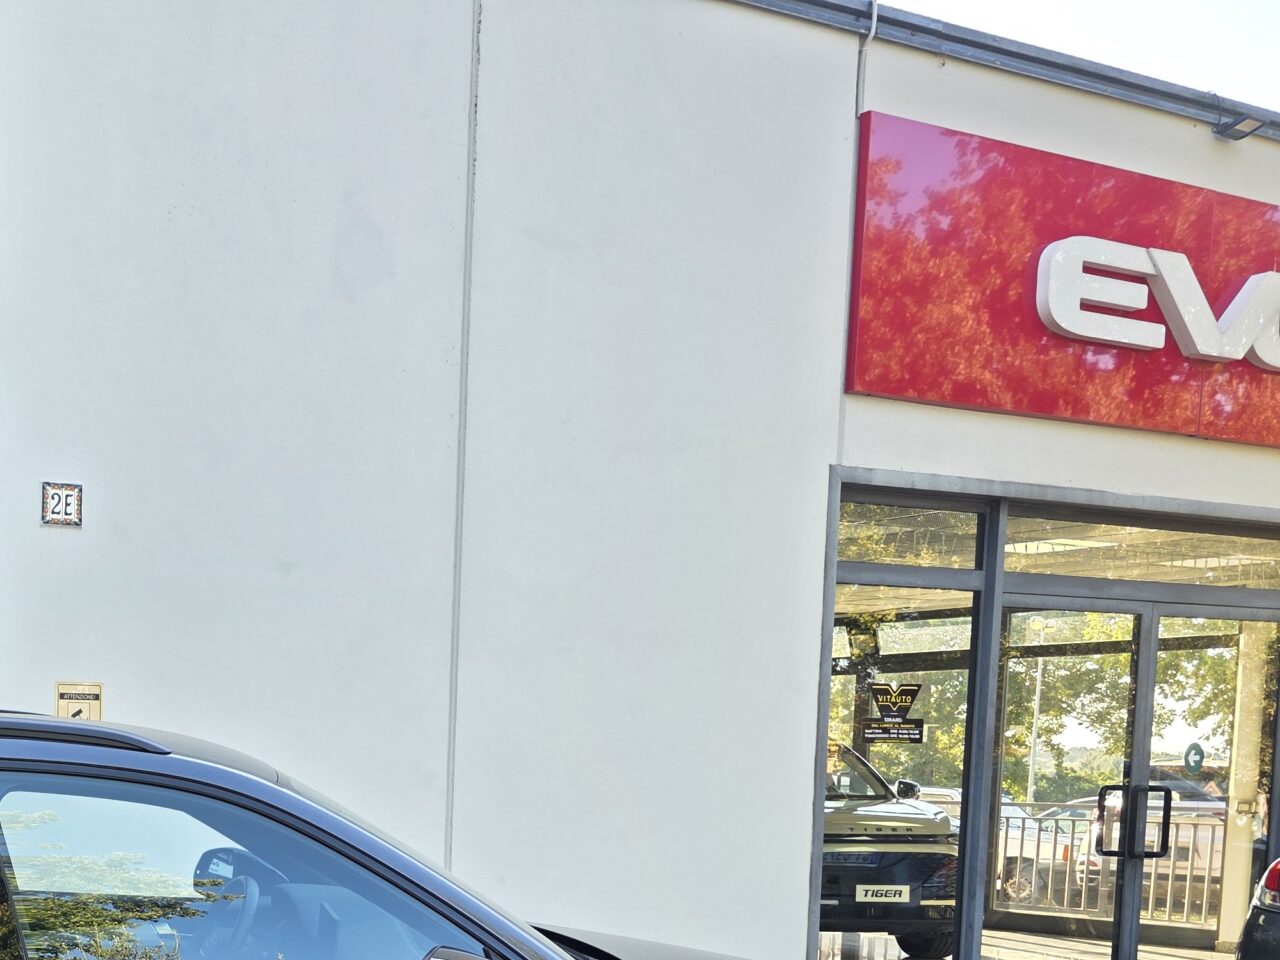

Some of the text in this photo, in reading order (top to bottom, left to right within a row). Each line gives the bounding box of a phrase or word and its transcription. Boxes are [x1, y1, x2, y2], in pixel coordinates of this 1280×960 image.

[1036, 236, 1280, 371] EV
[50, 492, 74, 516] 2E
[877, 694, 912, 703] VITAUTO
[862, 888, 903, 898] TIGER
